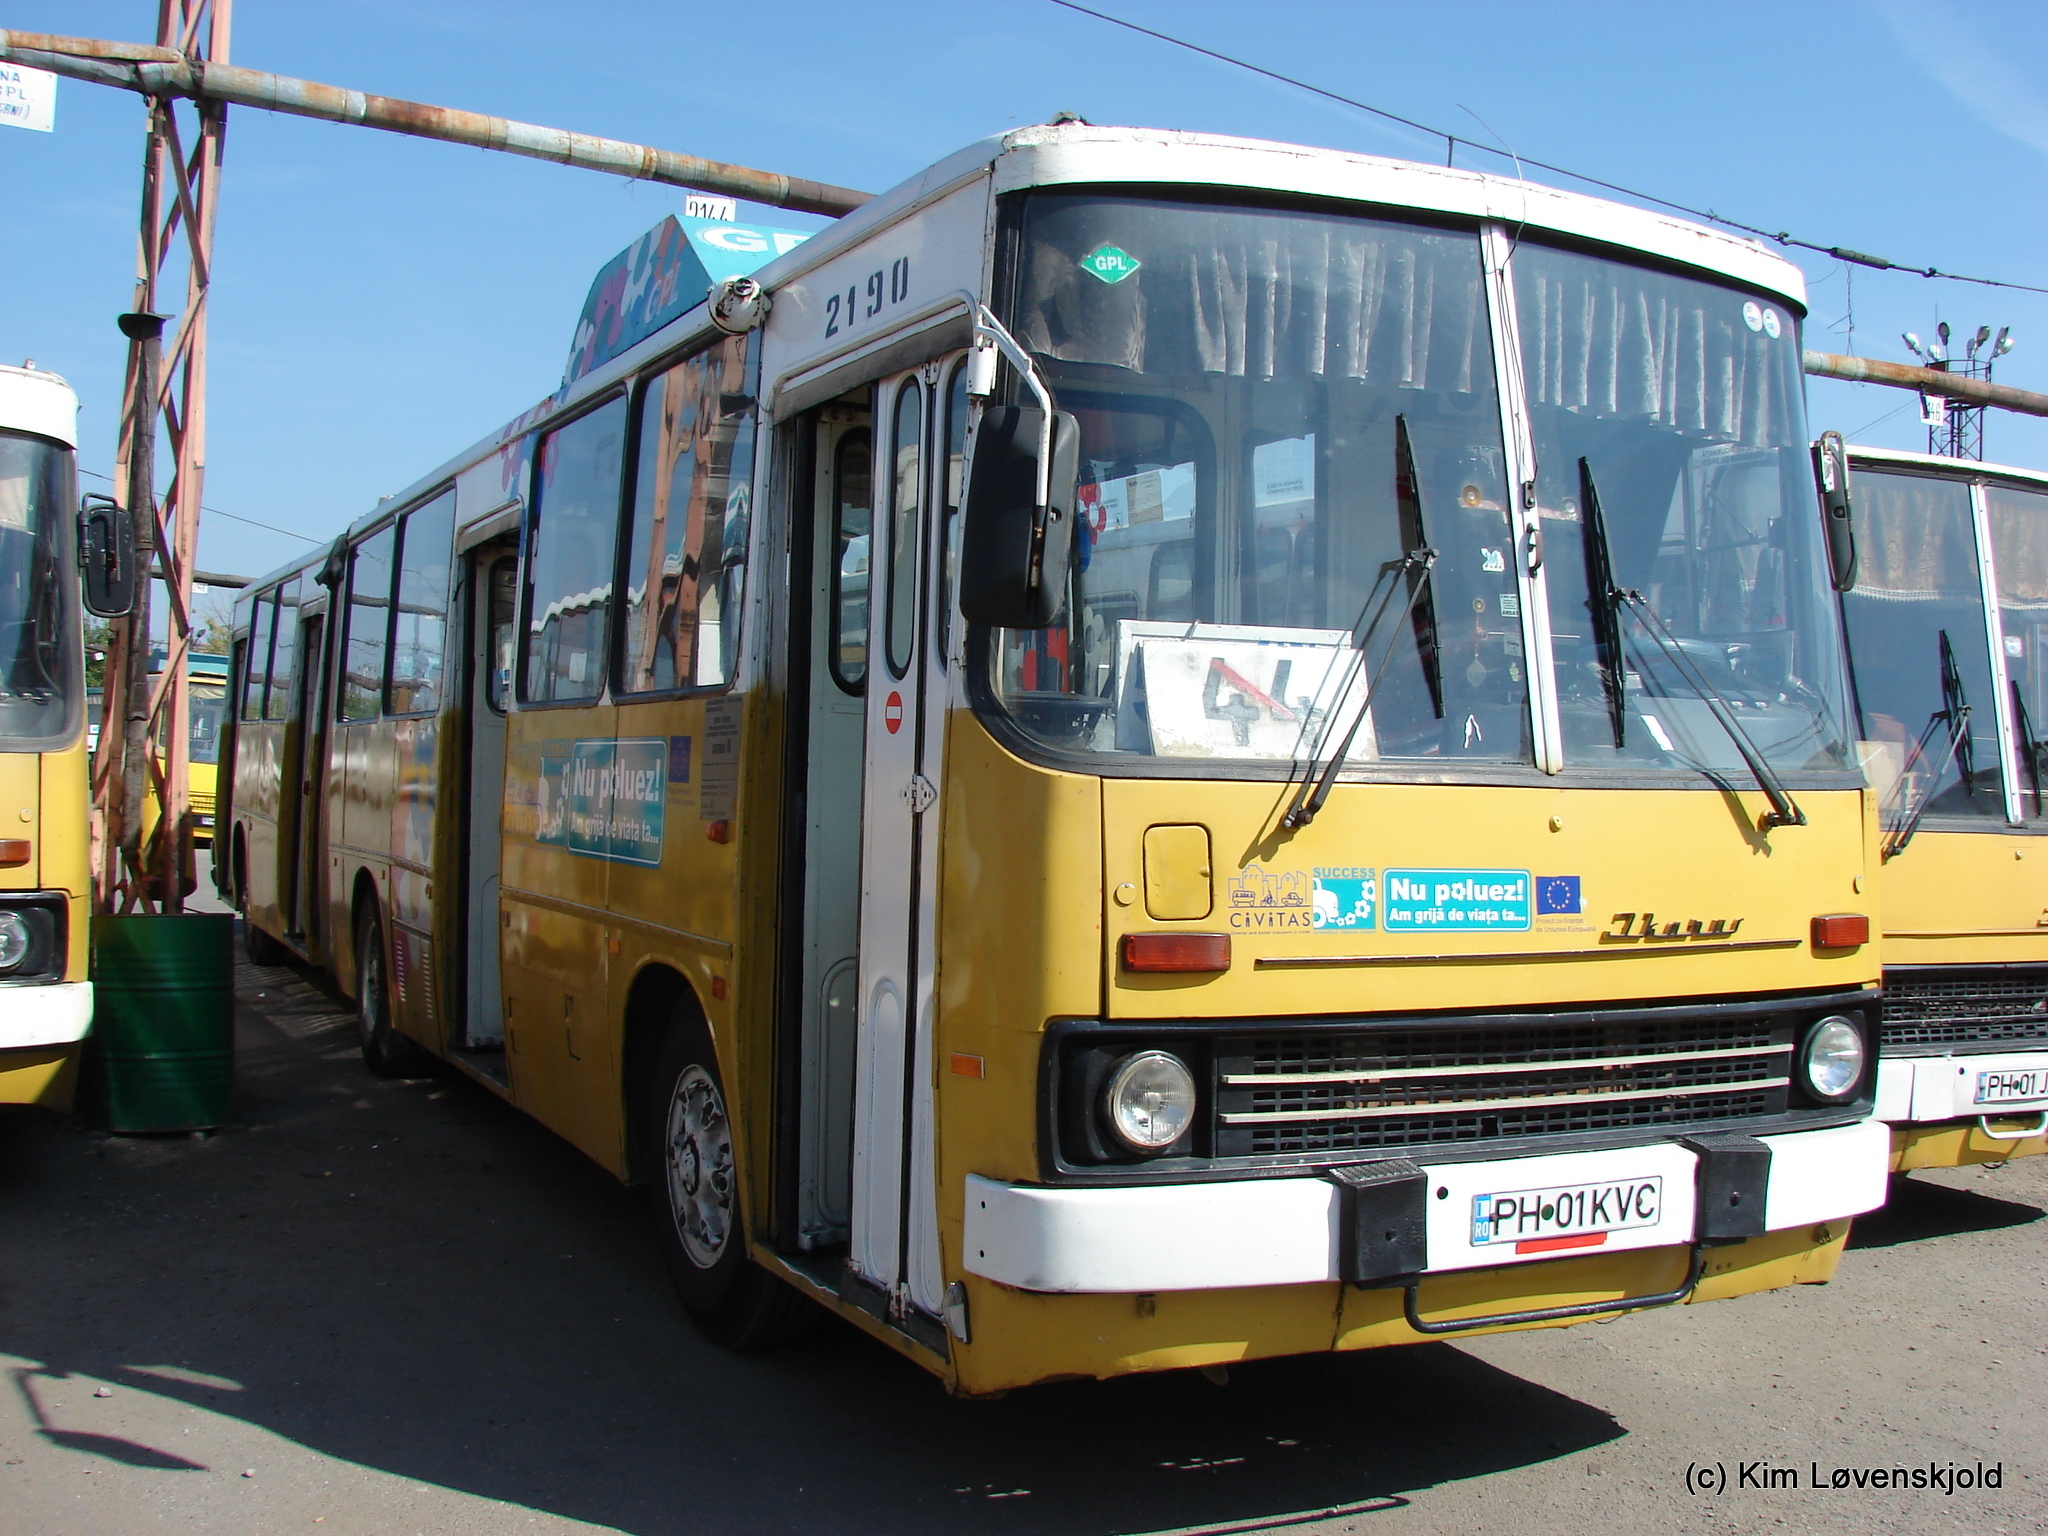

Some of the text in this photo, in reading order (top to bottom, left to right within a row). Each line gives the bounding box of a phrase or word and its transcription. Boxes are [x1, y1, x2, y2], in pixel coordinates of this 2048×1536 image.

[1095, 256, 1127, 271] GPL
[825, 256, 909, 339] 2190
[574, 758, 596, 797] Nu
[571, 812, 584, 834] Am
[1313, 867, 1376, 878] SUCCESS
[1390, 878, 1524, 906] Nu poluez!
[1389, 908, 1411, 921] Am
[1447, 908, 1464, 921] de
[1493, 1194, 1541, 1236] PH
[1475, 1220, 1489, 1238] RO
